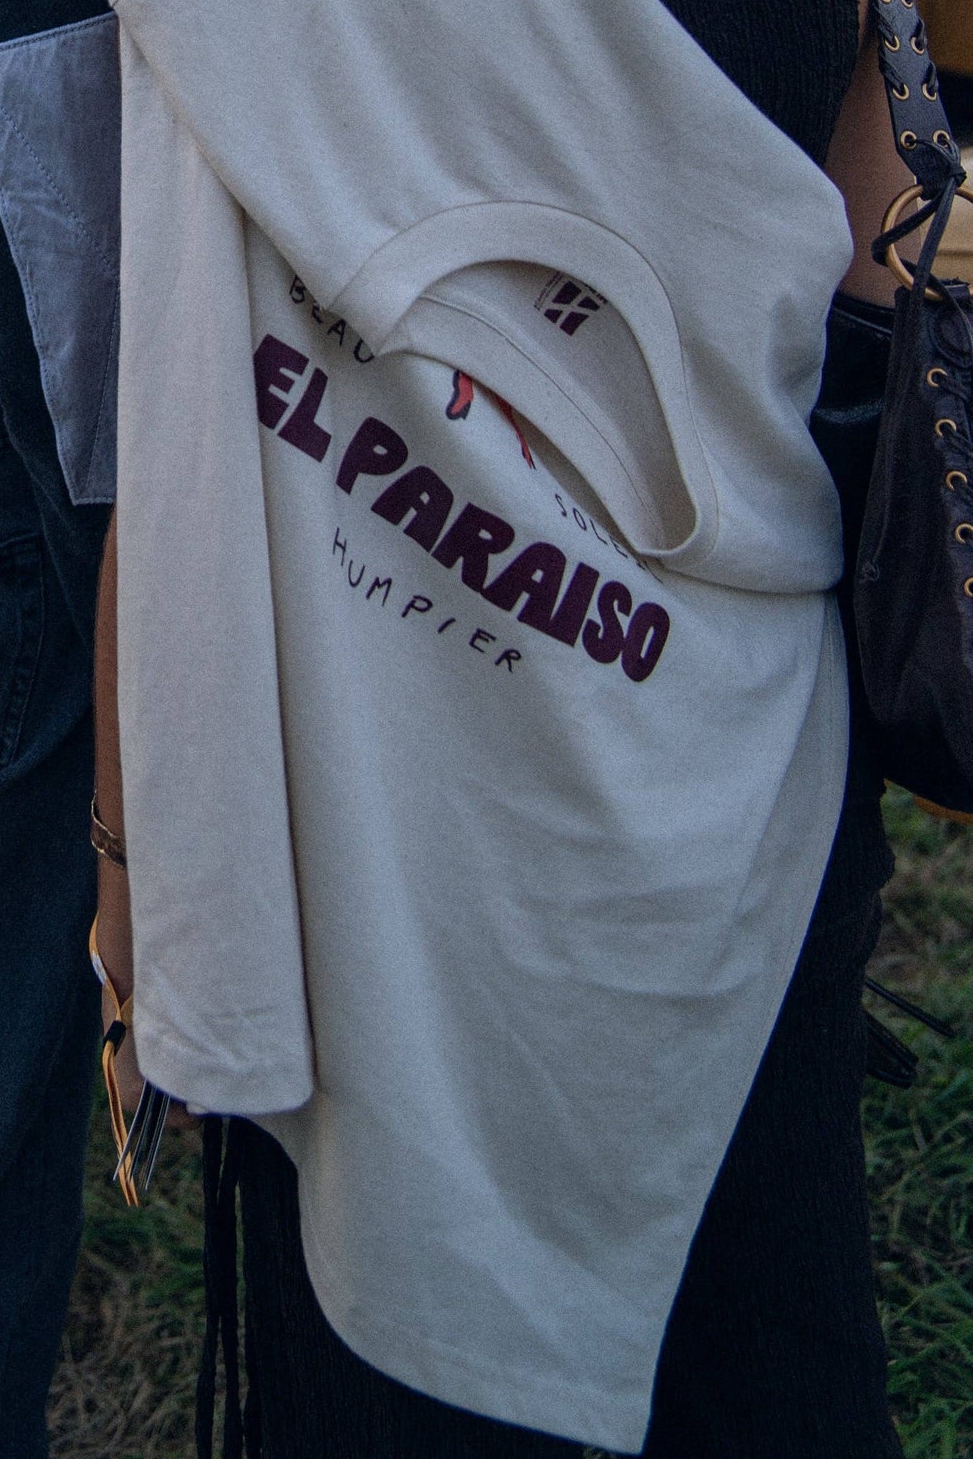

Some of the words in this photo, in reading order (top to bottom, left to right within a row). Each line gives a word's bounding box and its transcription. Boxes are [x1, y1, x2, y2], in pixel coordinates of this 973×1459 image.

[253, 333, 332, 463] EL
[335, 416, 671, 683] PARAISO
[332, 527, 522, 673] HUMPIER
